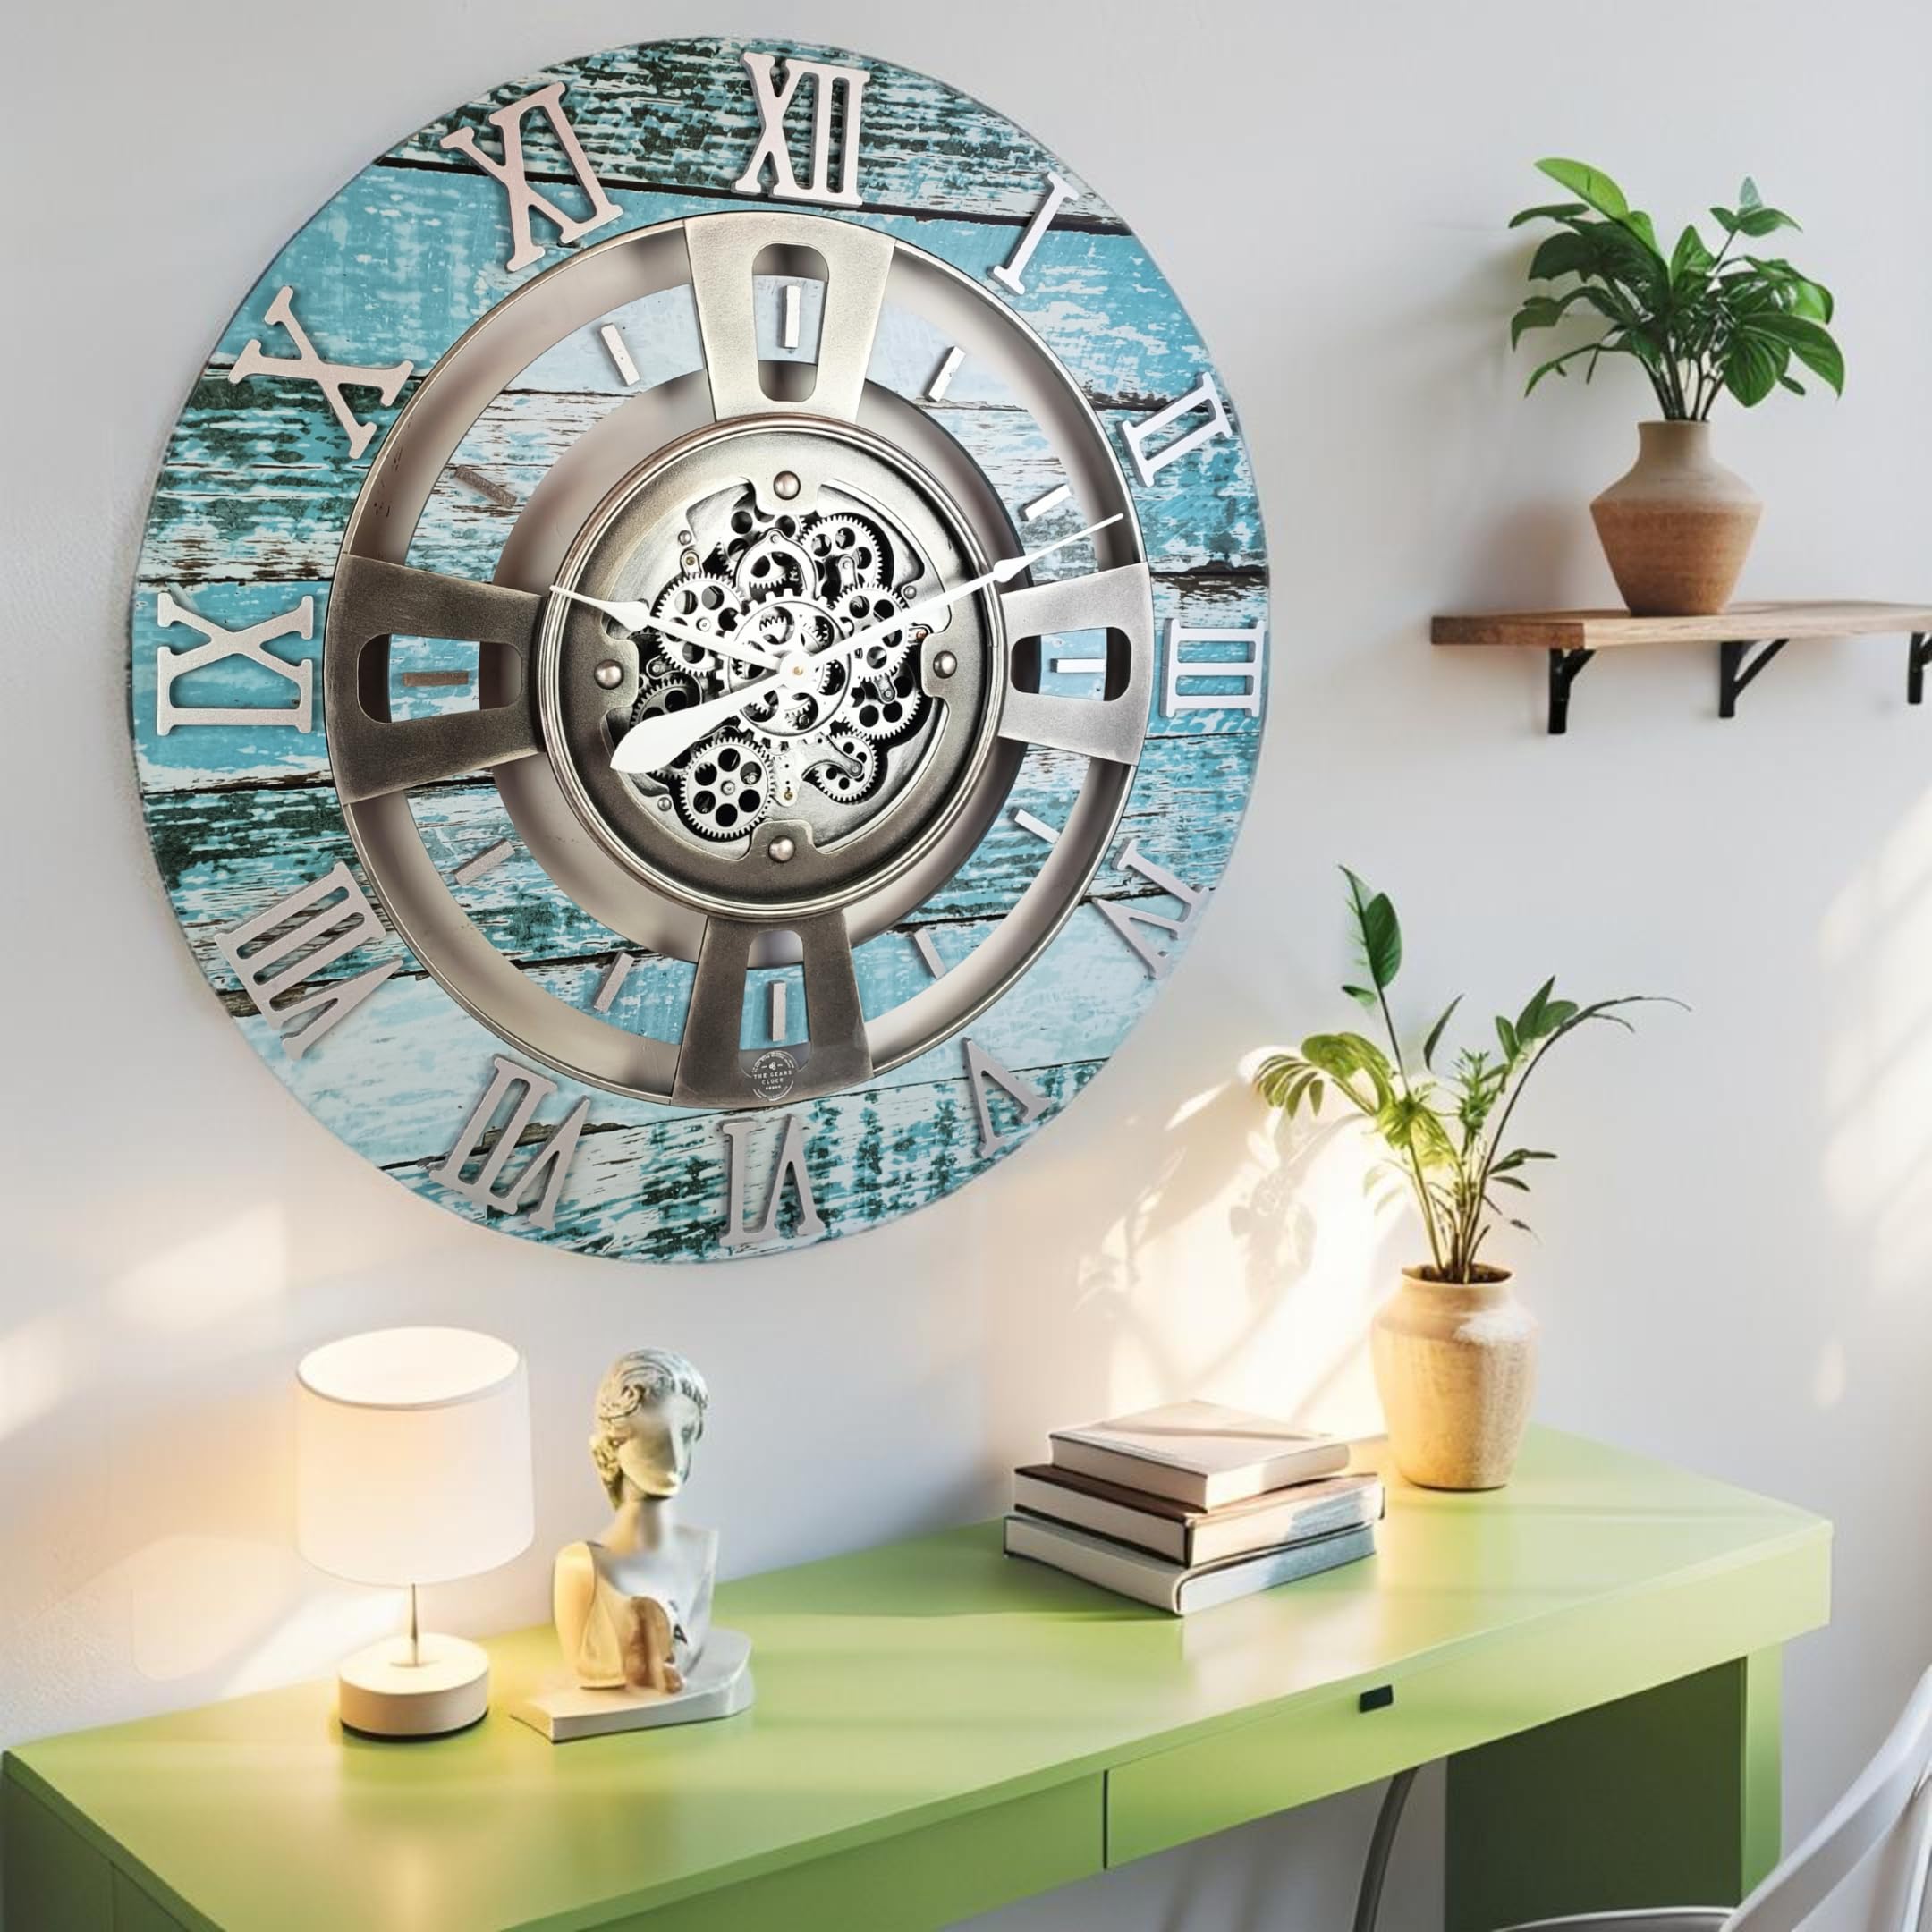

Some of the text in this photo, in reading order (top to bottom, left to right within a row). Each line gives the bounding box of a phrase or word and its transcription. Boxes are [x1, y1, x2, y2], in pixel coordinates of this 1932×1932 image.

[440, 81, 623, 272] XI
[732, 51, 869, 206] XII
[991, 171, 1080, 296] I
[228, 285, 414, 459] X
[1121, 371, 1233, 488] II
[157, 593, 315, 737] IX
[1164, 619, 1266, 717] III
[215, 861, 404, 1061] VIII
[1093, 838, 1209, 980] IV
[429, 1054, 591, 1230] VII
[769, 1070, 792, 1078] GEARS
[962, 1037, 1053, 1157] V
[719, 1113, 826, 1246] VI
